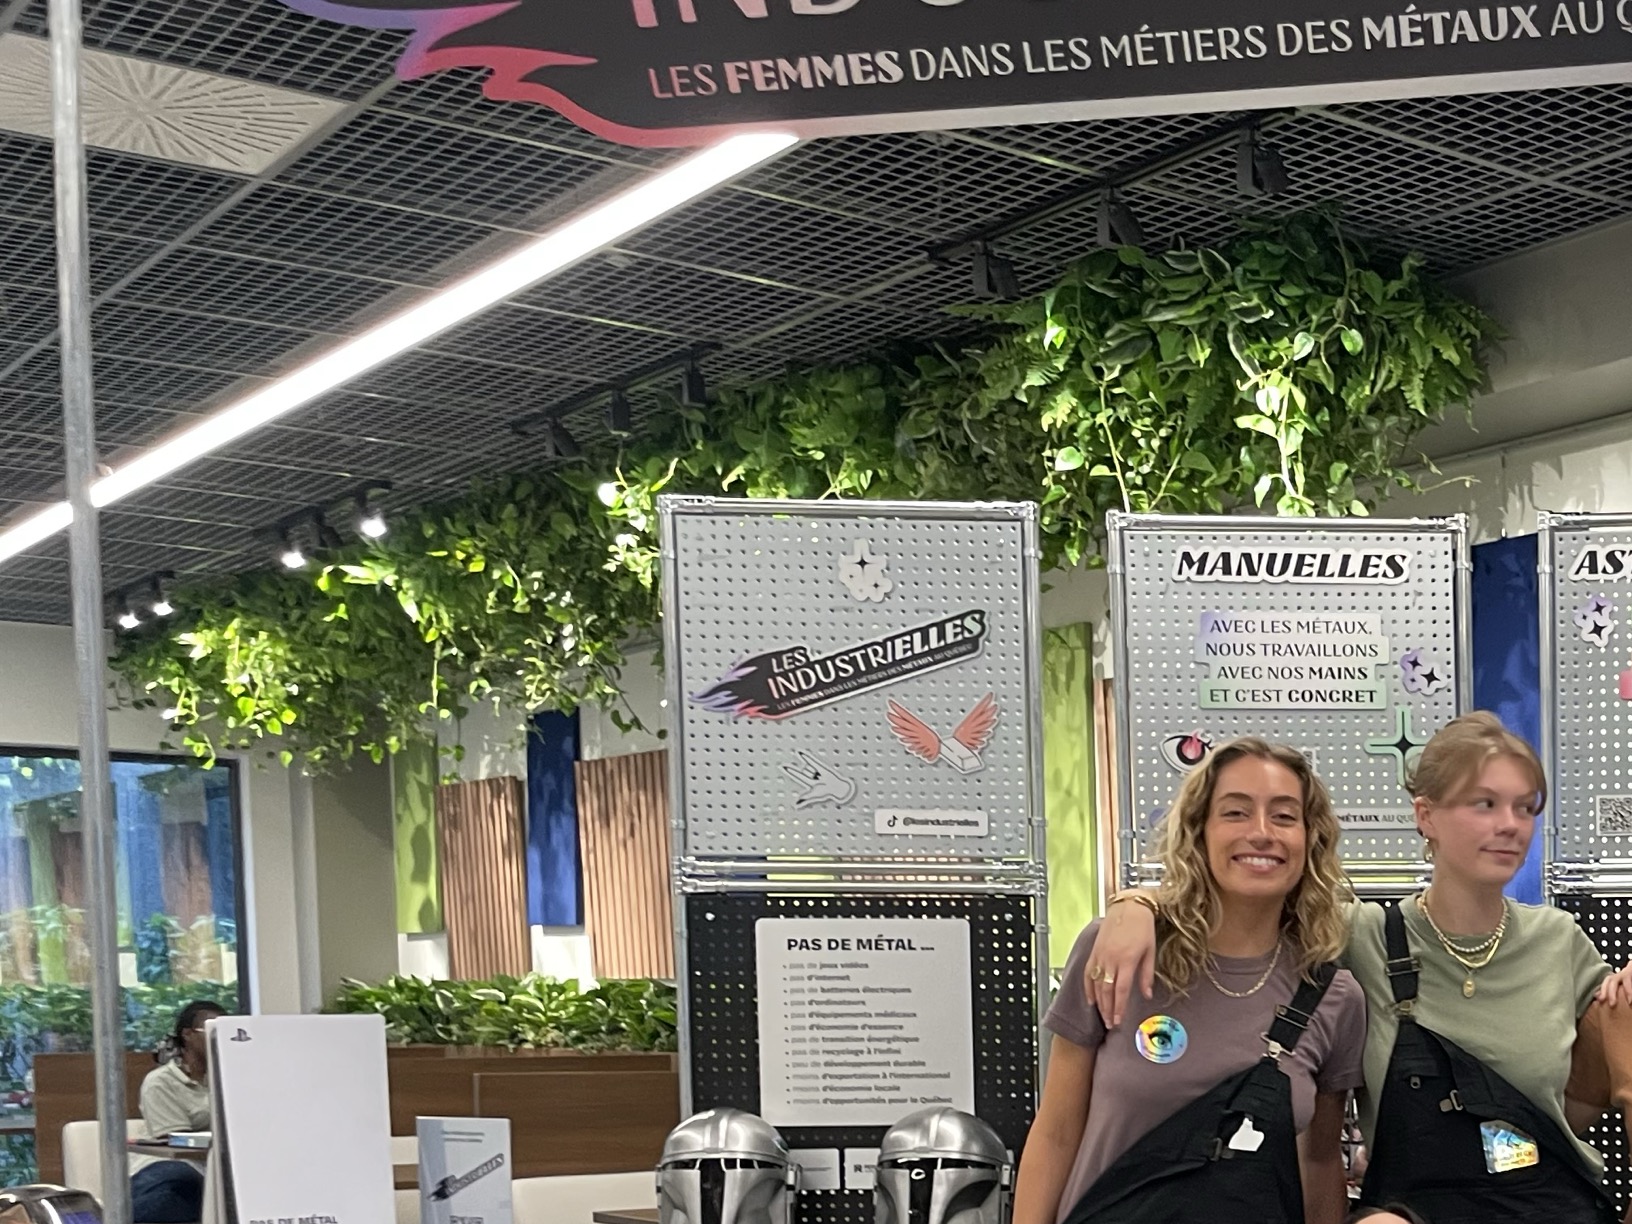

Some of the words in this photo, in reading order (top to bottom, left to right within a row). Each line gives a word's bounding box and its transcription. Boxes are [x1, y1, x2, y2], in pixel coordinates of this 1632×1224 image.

[648, 64, 718, 98] LES
[723, 50, 904, 94] FEMMES
[910, 42, 1015, 81] DANS
[1022, 37, 1092, 73] LES
[1100, 24, 1267, 67] MÉTIERS
[1277, 19, 1353, 56] DES
[1362, 3, 1542, 50] MÉTAUX
[1550, 0, 1604, 36] AU
[1176, 550, 1408, 579] MANUELLES
[1210, 620, 1256, 634] AVEC
[1260, 620, 1291, 634] LES
[767, 614, 982, 699] INDUSTRIELLES
[1205, 643, 1256, 657] NOUS
[1260, 643, 1379, 657] TRAVAILLONS
[771, 649, 807, 674] LES
[1217, 666, 1263, 680] AVEC
[1267, 666, 1304, 680] NOS
[1308, 666, 1368, 680] MAINS
[1210, 689, 1231, 703] ET
[1235, 689, 1283, 703] C'EST
[1287, 689, 1377, 703] CONCRET
[787, 938, 822, 951] PAS
[827, 938, 852, 950] DE
[856, 934, 917, 951] MÉTAL
